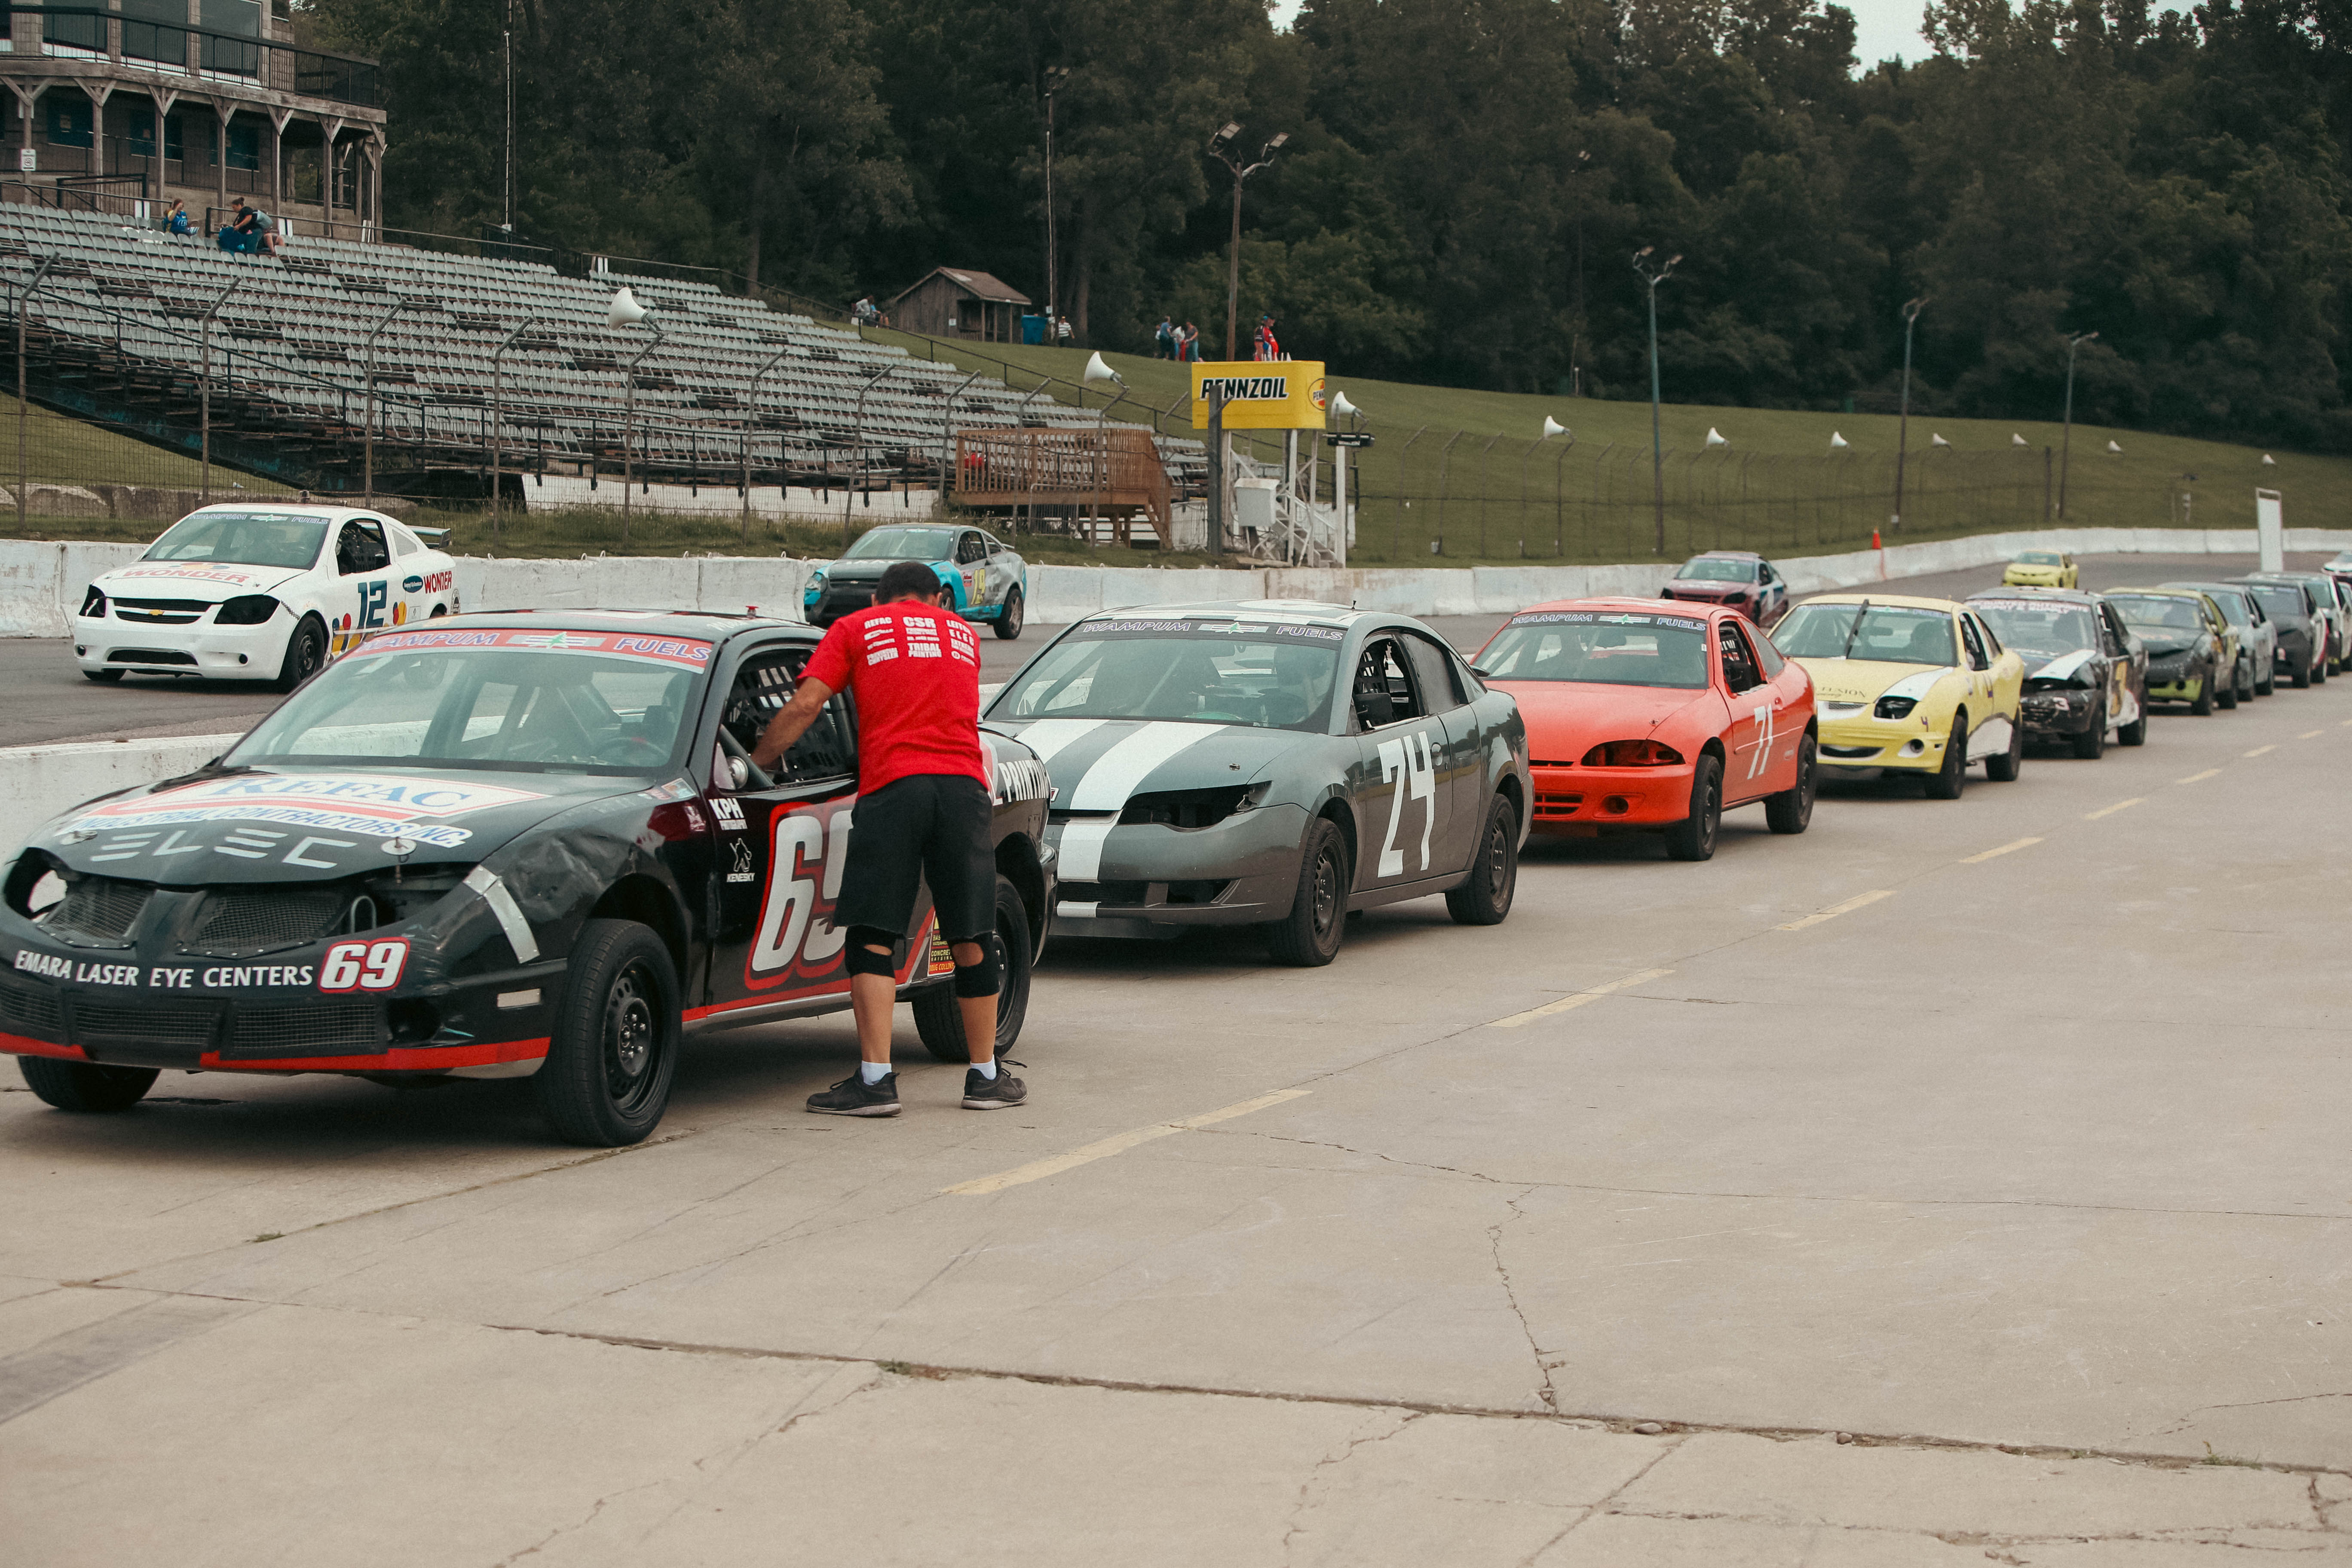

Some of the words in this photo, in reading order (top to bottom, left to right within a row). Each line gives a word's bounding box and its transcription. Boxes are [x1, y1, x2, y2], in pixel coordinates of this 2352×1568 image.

[291, 516, 329, 525] FUELS
[123, 569, 249, 583] WONDER
[424, 570, 452, 594] WONDER
[356, 579, 387, 629] 12
[902, 616, 937, 629] CSR
[1083, 622, 1191, 632] WAMPUM
[1275, 626, 1344, 640] FUELS
[1512, 614, 1593, 625] WAMPUM
[1656, 618, 1706, 631] FUELS
[358, 633, 501, 652] WAMPUM
[612, 637, 712, 661] FUELS
[907, 643, 940, 652] TRIBAL
[2052, 696, 2070, 712] 3
[1746, 703, 1774, 780] 71
[214, 777, 473, 808] REFAC
[1377, 731, 1436, 878] 24
[708, 798, 744, 820] KPH
[211, 807, 405, 835] CONTRACTORS
[407, 825, 466, 845] INC.
[14, 949, 73, 979] EMARA
[76, 963, 139, 986] LASER
[149, 968, 193, 988] EYE
[203, 965, 313, 987] CENTERS
[319, 939, 409, 992] 69
